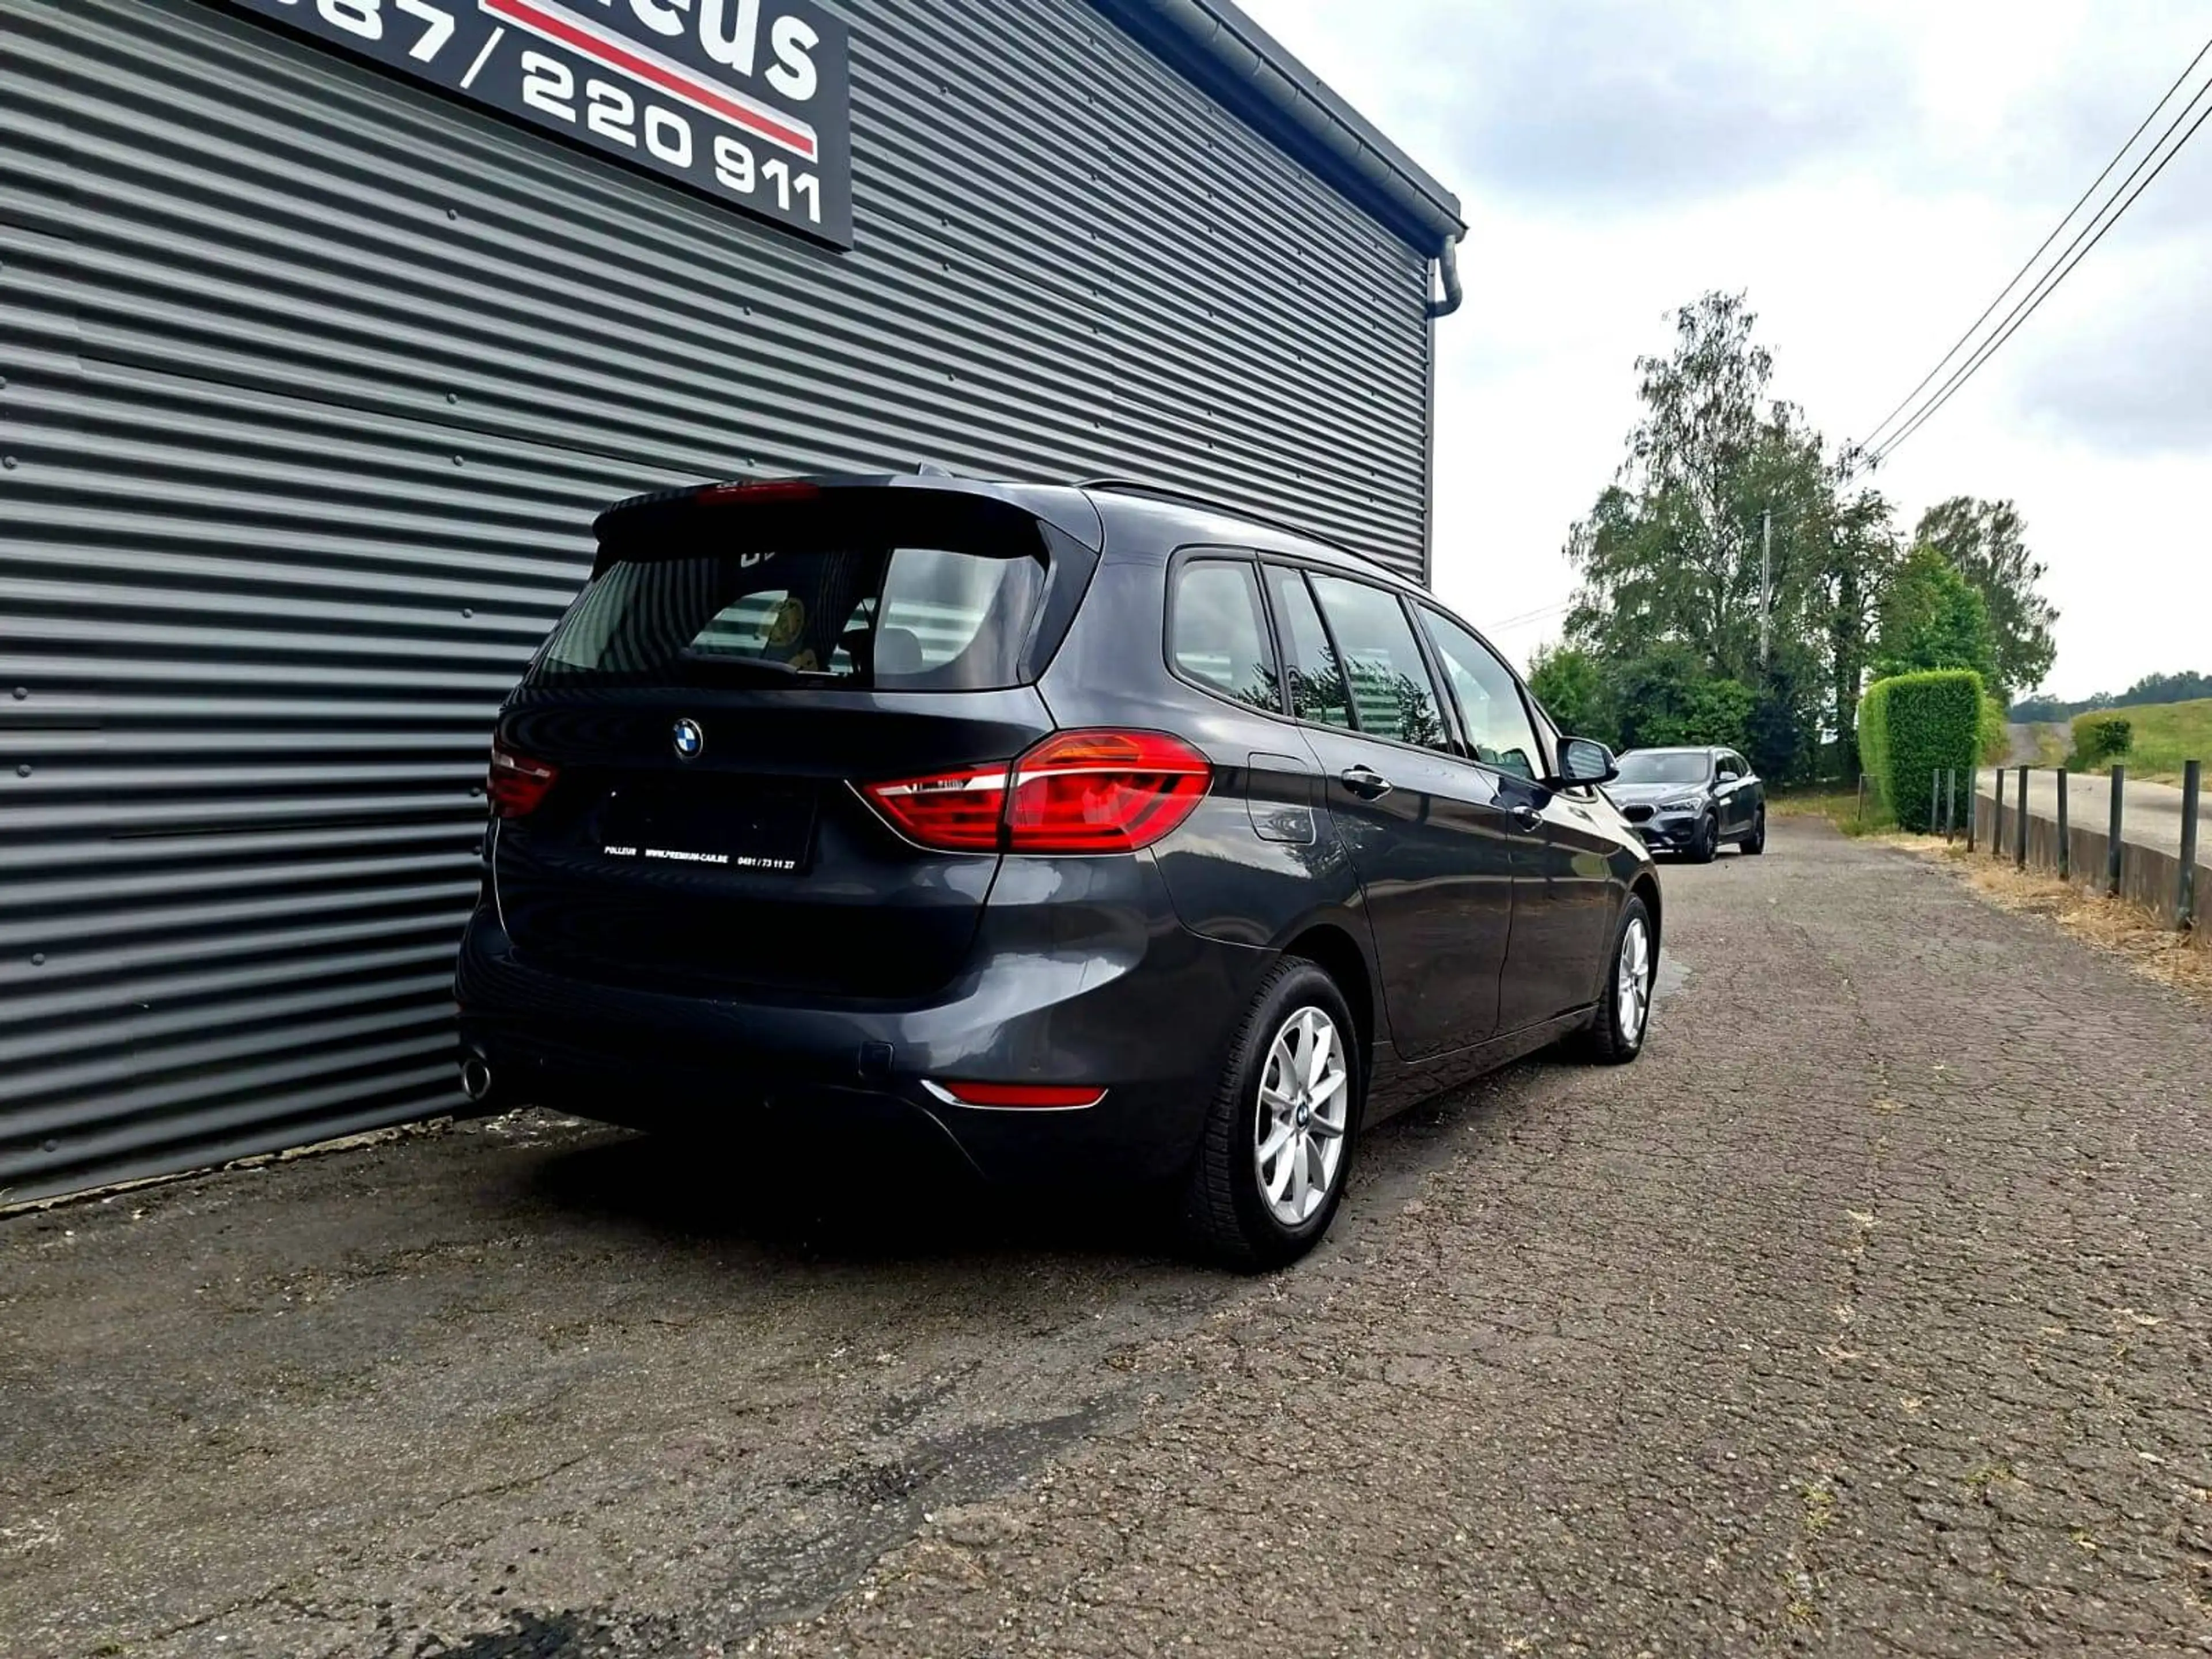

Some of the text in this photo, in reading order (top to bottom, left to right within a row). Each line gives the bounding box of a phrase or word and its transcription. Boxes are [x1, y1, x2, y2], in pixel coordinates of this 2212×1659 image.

[276, 0, 454, 62] 87
[522, 51, 692, 168] 220
[714, 135, 820, 223] 911
